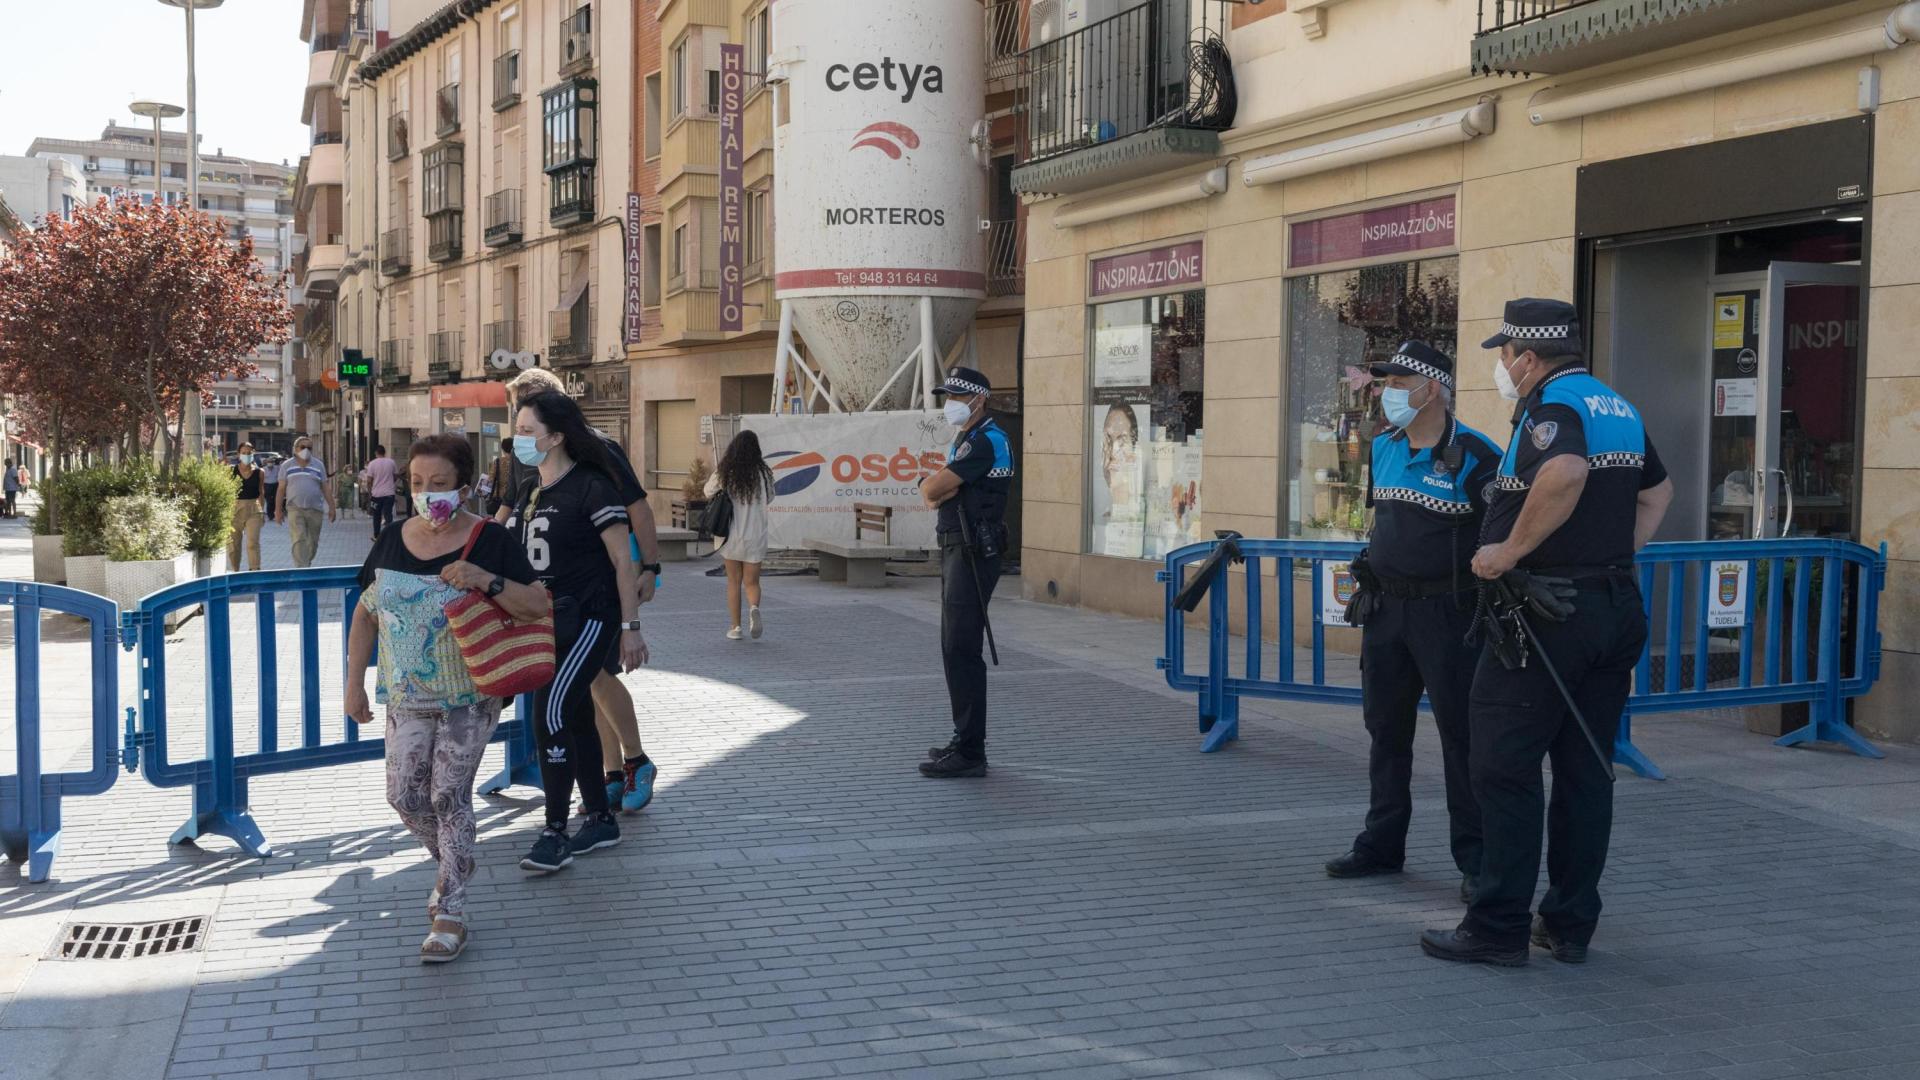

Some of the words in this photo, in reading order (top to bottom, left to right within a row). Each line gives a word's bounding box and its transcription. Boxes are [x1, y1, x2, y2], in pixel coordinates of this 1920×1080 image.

[825, 57, 943, 103] cetya
[722, 53, 740, 170] HOSTAL
[826, 208, 945, 226] MORTEROS
[629, 195, 639, 340] RESTAURANTE
[723, 186, 740, 322] REMIGIO
[835, 272, 856, 284] Tel:
[859, 271, 883, 284] 948
[887, 272, 901, 284] 31
[906, 272, 921, 284] 64
[924, 272, 938, 284] 64
[342, 364, 368, 374] 11:05
[831, 447, 946, 484] osés
[835, 487, 918, 497] CONSTRUCC
[1422, 475, 1453, 490] POLICIA
